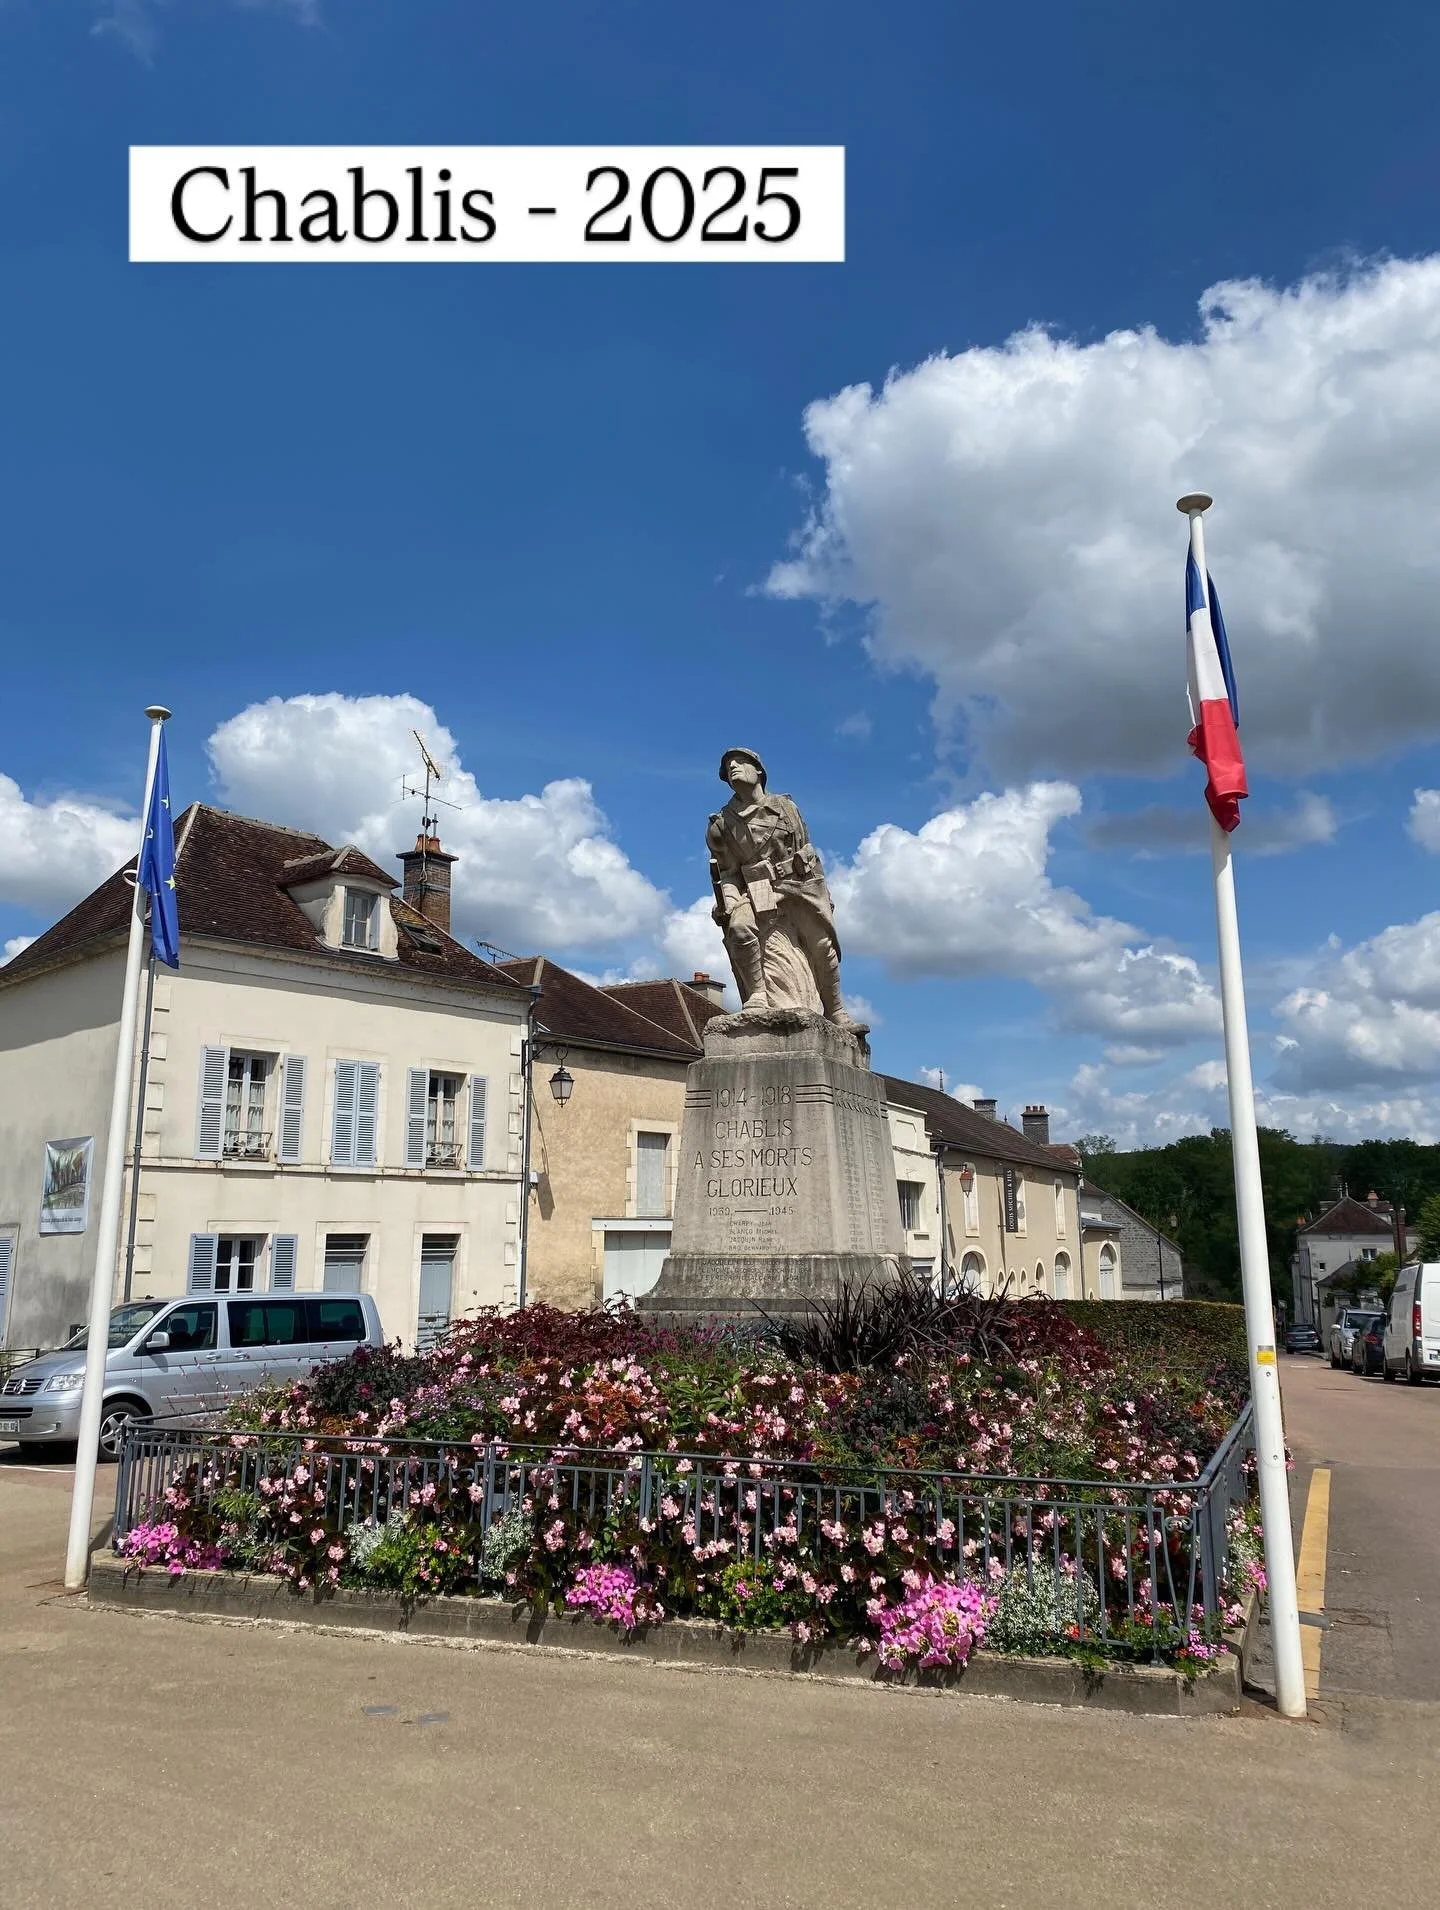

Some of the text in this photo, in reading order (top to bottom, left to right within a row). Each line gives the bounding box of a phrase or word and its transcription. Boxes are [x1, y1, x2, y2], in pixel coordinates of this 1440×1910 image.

[714, 1118, 793, 1140] CHABLIS
[710, 1149, 745, 1169] SES
[750, 1147, 813, 1168] MORTS
[706, 1176, 799, 1198] GLORIEUX
